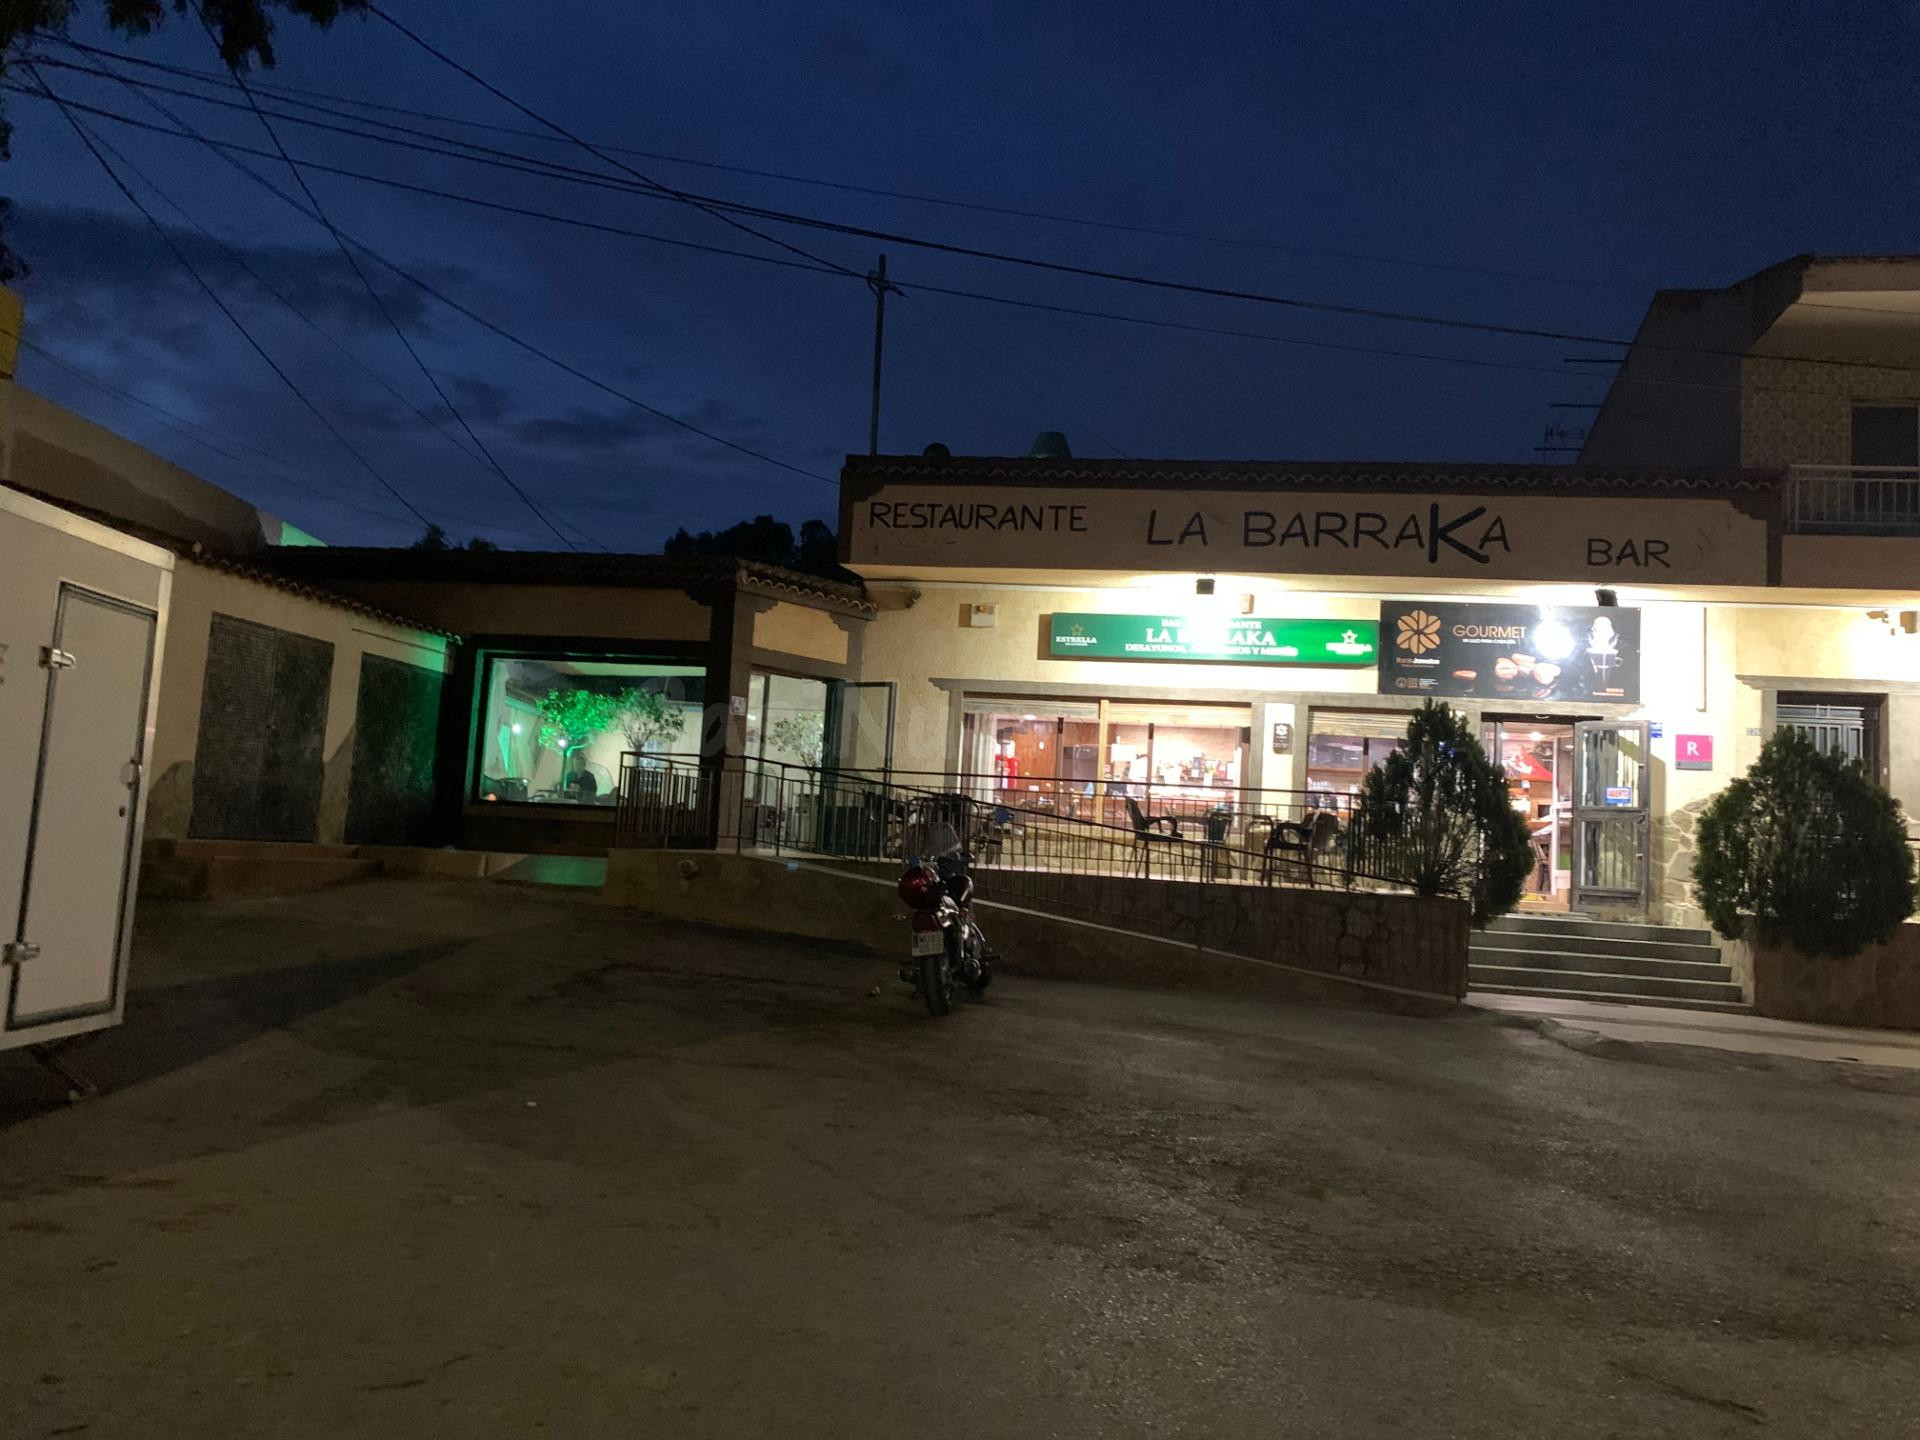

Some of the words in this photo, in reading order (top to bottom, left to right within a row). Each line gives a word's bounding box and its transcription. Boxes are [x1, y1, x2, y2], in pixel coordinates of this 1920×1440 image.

[869, 501, 1089, 532] RESTAURANTE
[1146, 509, 1209, 547] LA
[1243, 502, 1511, 564] BARRAKA
[1586, 538, 1671, 569] BAR
[1146, 627, 1172, 643] LA
[1452, 624, 1527, 639] GOURMET
[1055, 636, 1097, 644] ESTRELLA
[1686, 741, 1699, 756] R
